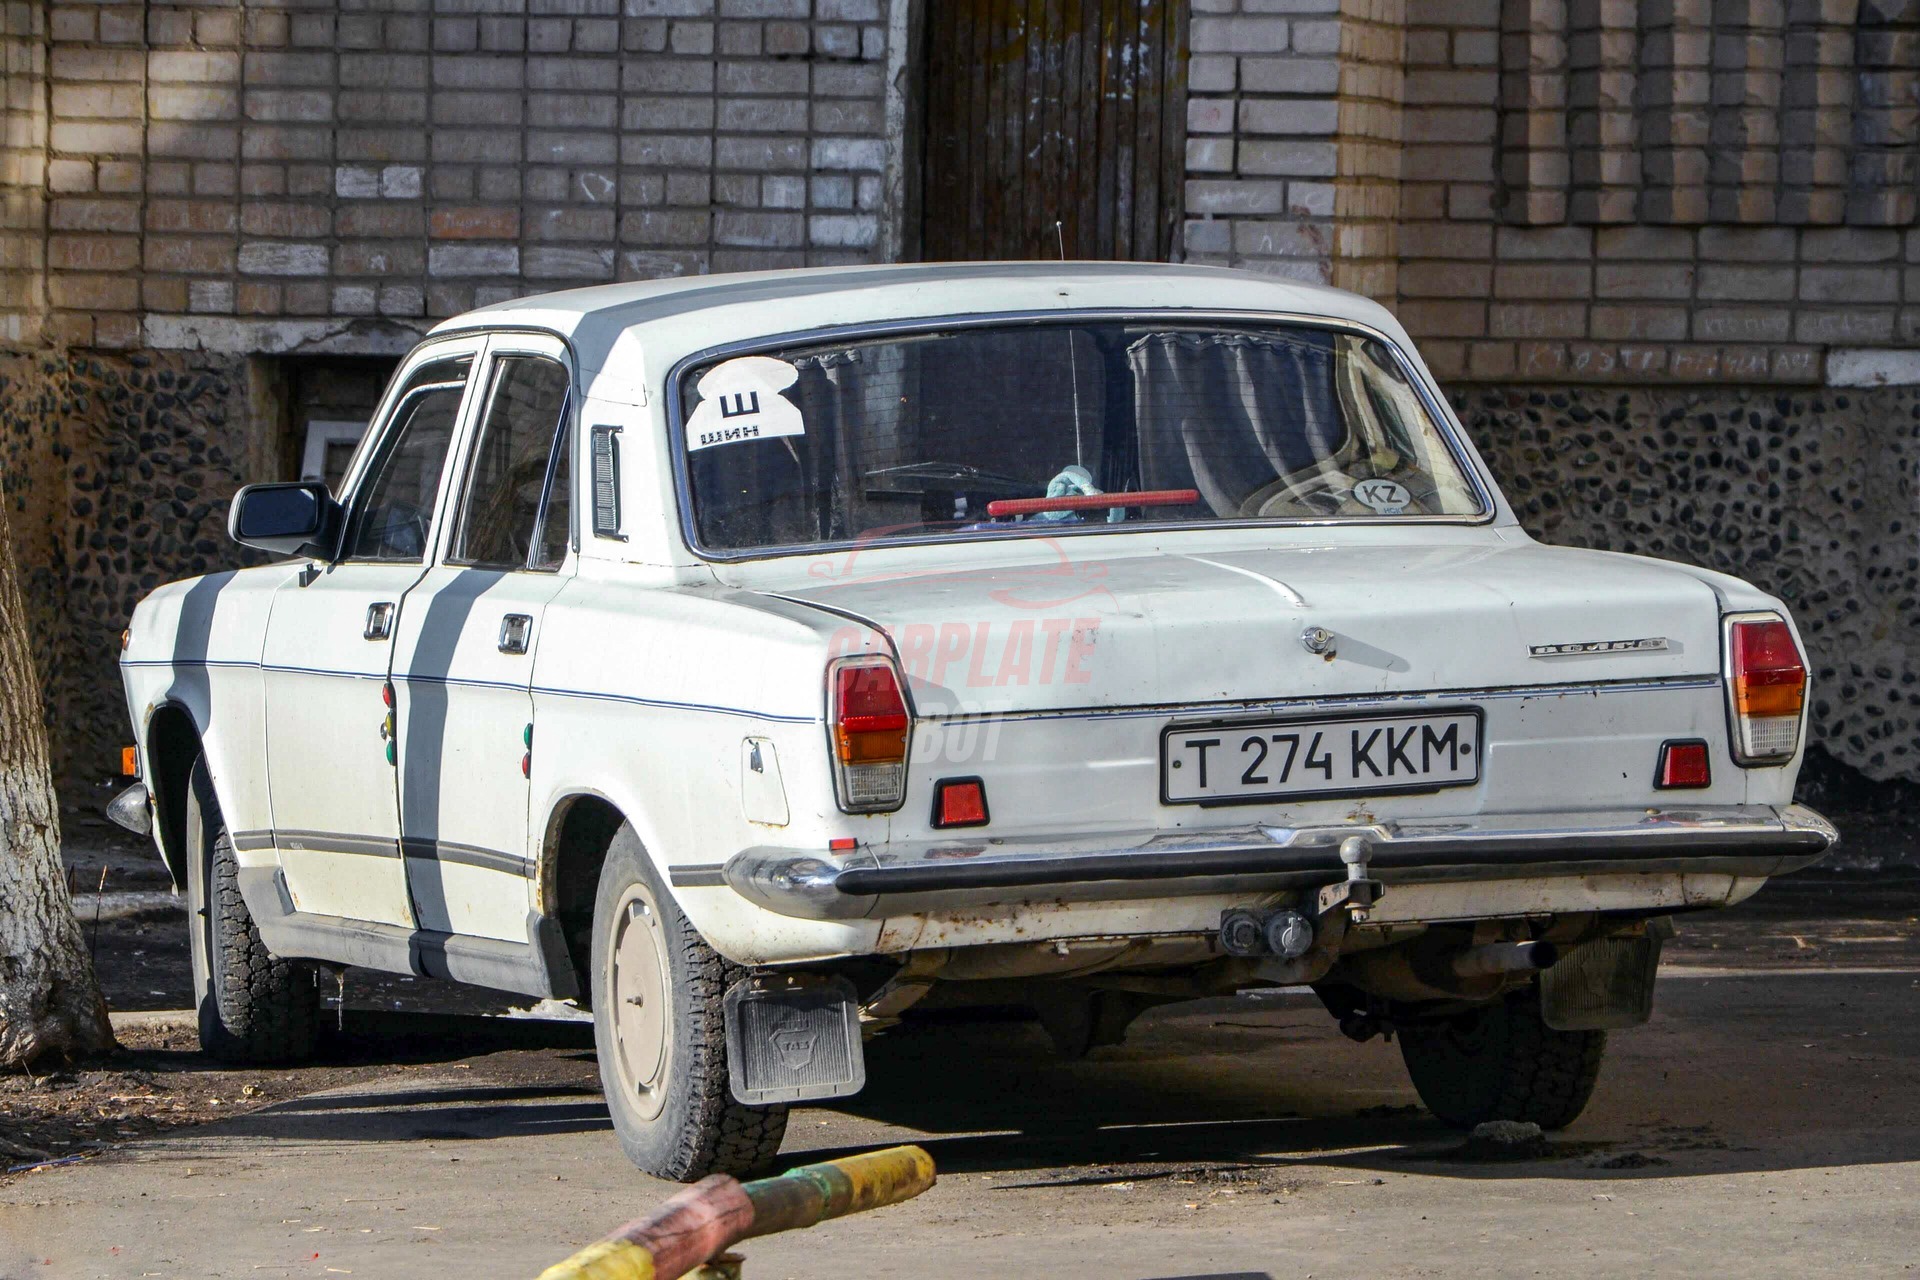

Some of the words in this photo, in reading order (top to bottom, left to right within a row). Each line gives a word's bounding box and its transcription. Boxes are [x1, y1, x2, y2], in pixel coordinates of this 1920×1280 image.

[719, 390, 760, 418] Ш
[1362, 485, 1402, 503] KZ
[1185, 739, 1220, 788] T
[1240, 731, 1332, 785] 274
[1352, 723, 1458, 778] KKM
